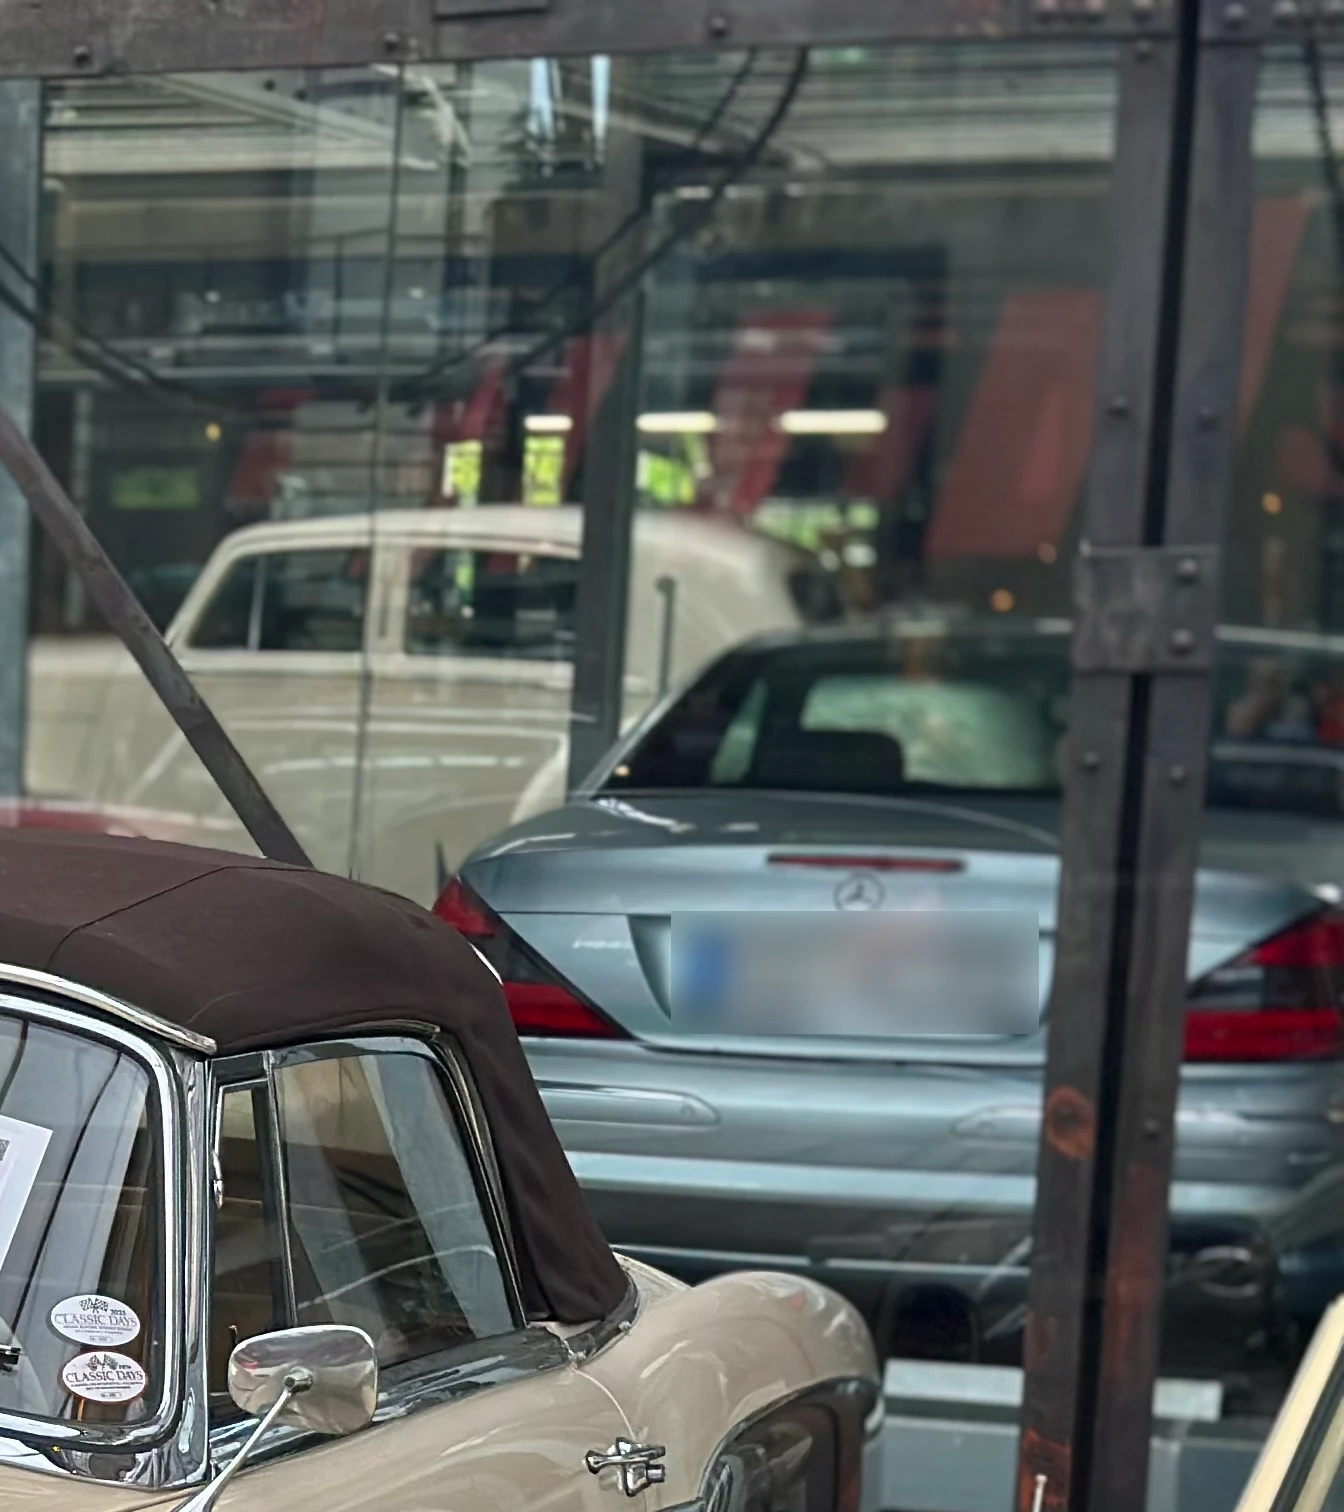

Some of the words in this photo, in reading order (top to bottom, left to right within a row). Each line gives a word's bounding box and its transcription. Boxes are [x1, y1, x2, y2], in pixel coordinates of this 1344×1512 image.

[54, 1313, 106, 1325] CLASSIC
[108, 1315, 138, 1328] DAYS
[66, 1371, 114, 1382] CLASSIC
[116, 1371, 143, 1381] DAYS
